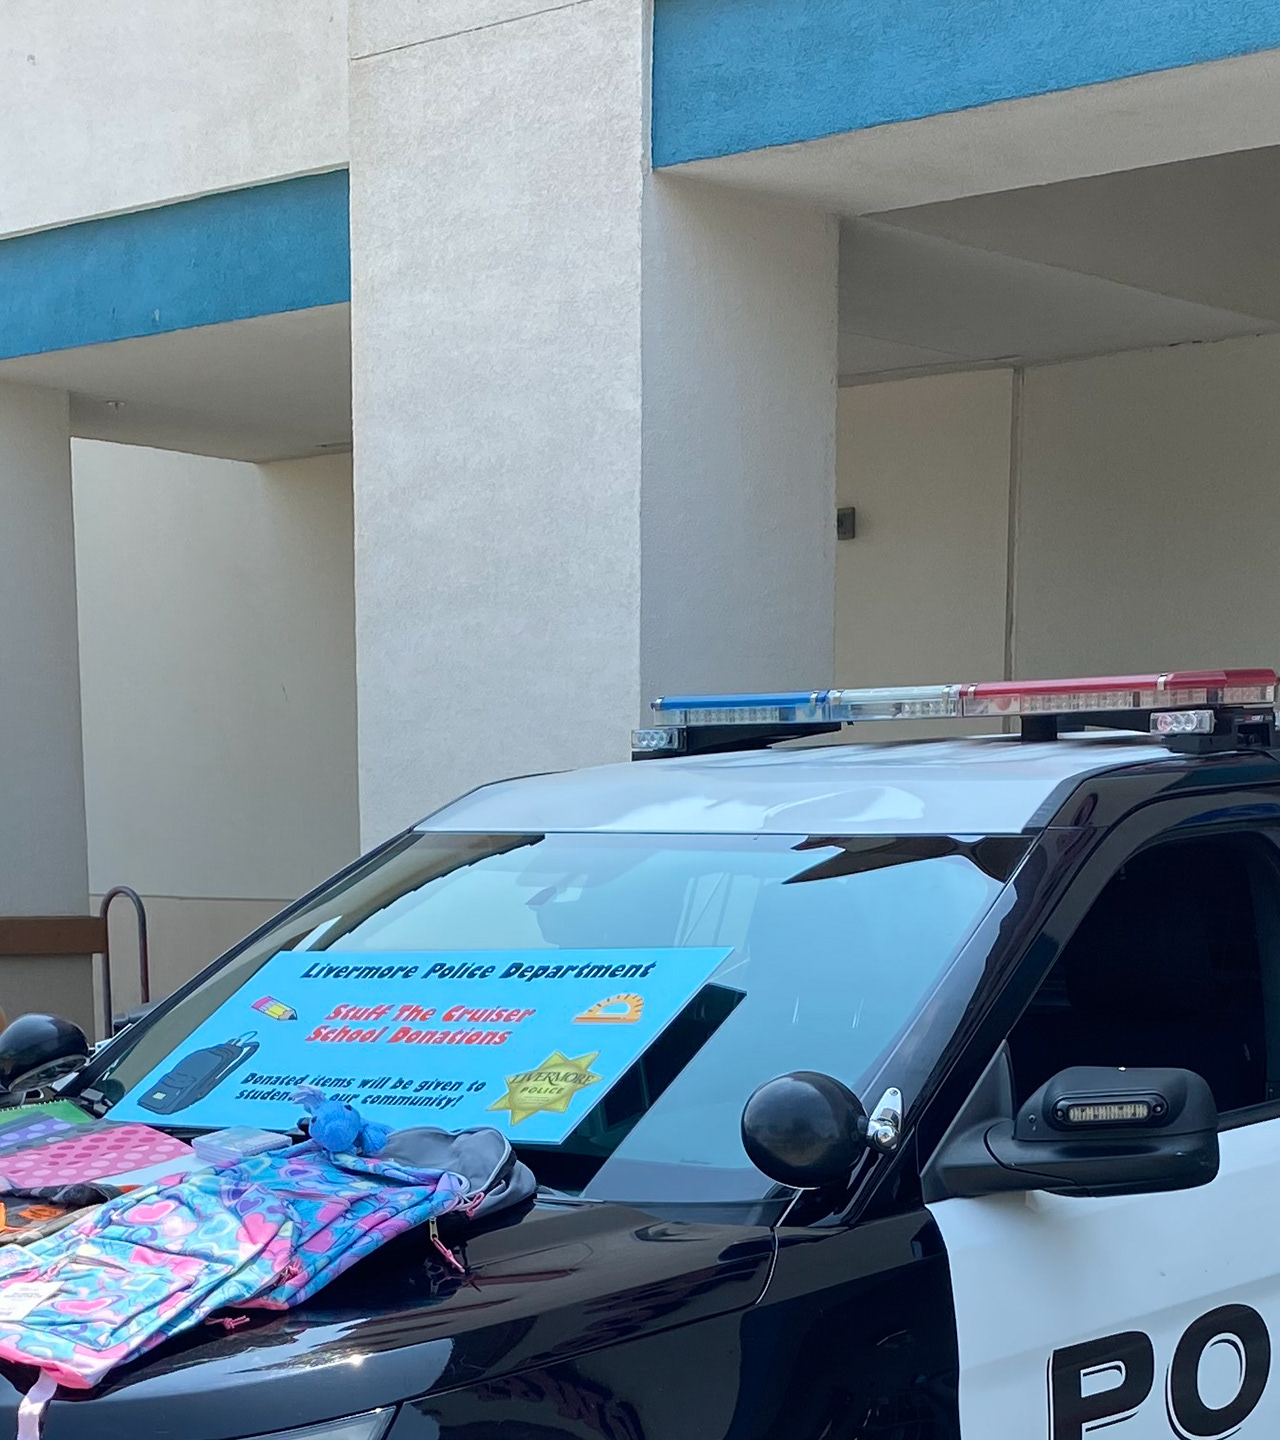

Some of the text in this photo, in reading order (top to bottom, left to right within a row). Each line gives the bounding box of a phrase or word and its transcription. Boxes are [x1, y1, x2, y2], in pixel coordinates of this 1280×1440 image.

[300, 961, 657, 983] Livermore Police Department
[324, 1004, 536, 1024] Stuff The Cruiser
[305, 1025, 515, 1046] School Donations
[241, 1072, 487, 1093] Donated items will be given to
[509, 1071, 596, 1087] LIVERMORE
[234, 1088, 296, 1101] studen
[361, 1094, 464, 1110] community!
[520, 1086, 566, 1095] POLICE
